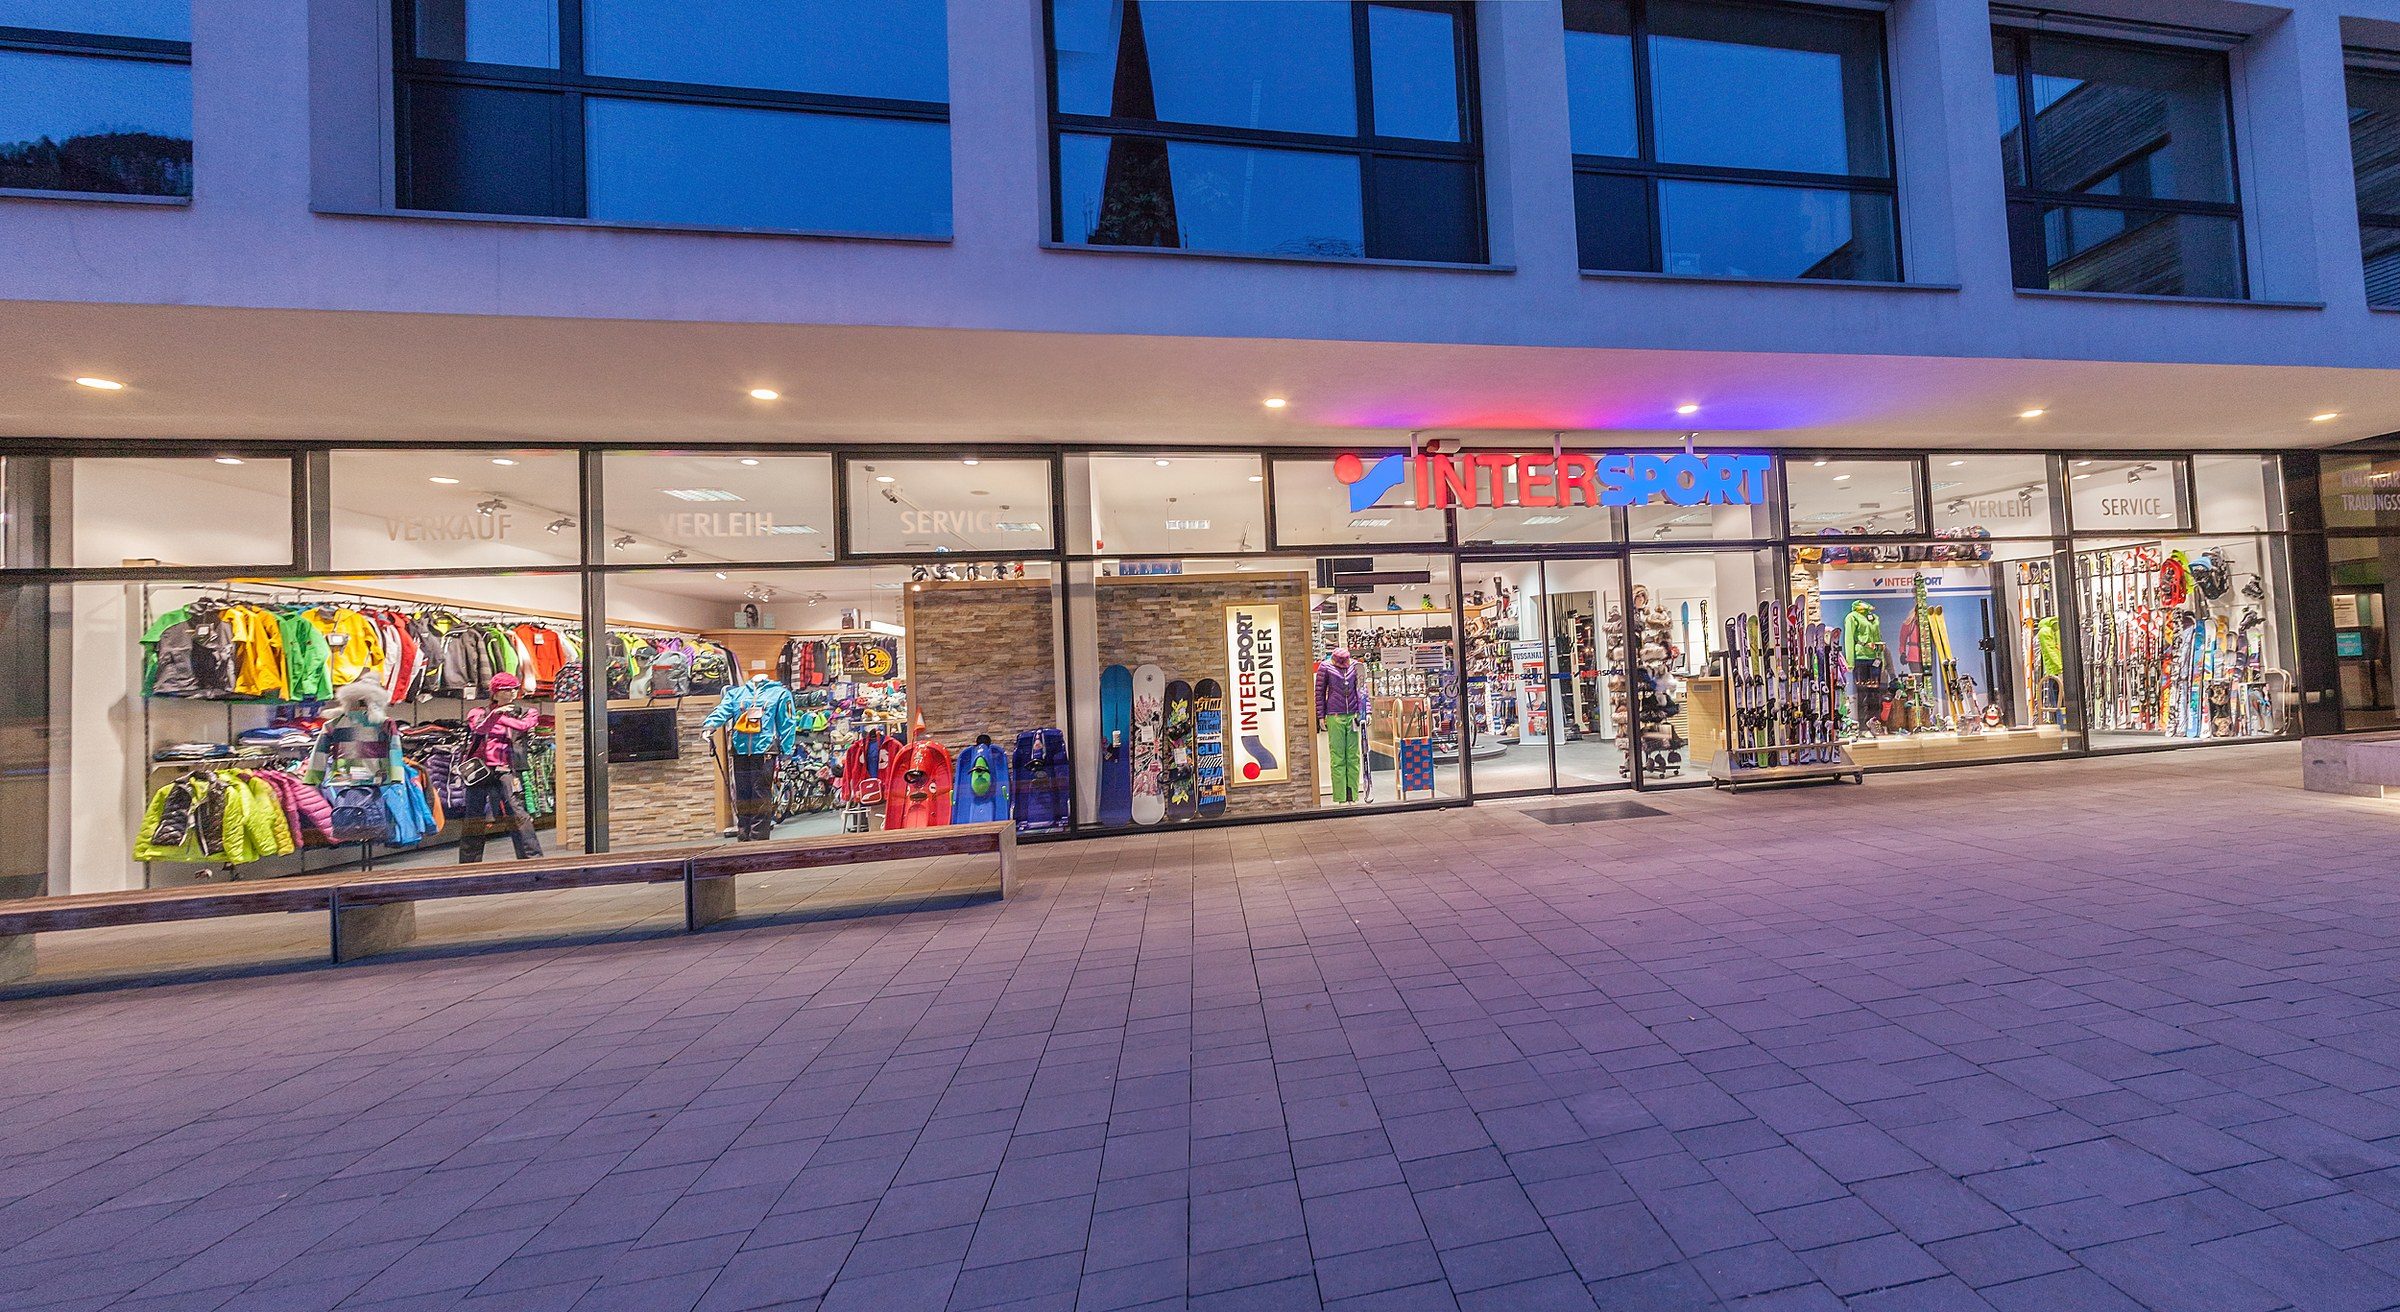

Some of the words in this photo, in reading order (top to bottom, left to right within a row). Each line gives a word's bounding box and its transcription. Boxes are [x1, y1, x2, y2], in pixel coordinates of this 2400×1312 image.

[1415, 453, 1771, 510] INTERSPORT
[1968, 499, 2032, 518] VERLEIH
[2101, 498, 2161, 516] SERVICE
[385, 514, 512, 541] VERKAUF
[657, 512, 773, 537] VERLEIH
[900, 510, 1001, 534] SERVICE
[1884, 576, 1942, 587] INTERORT
[1772, 606, 1781, 647] HEAD
[1513, 650, 1554, 660] FUSSANALE
[1236, 611, 1259, 731] INTERSPORT
[1257, 628, 1275, 712] LADNER
[1497, 672, 1543, 680] INTERSPORT
